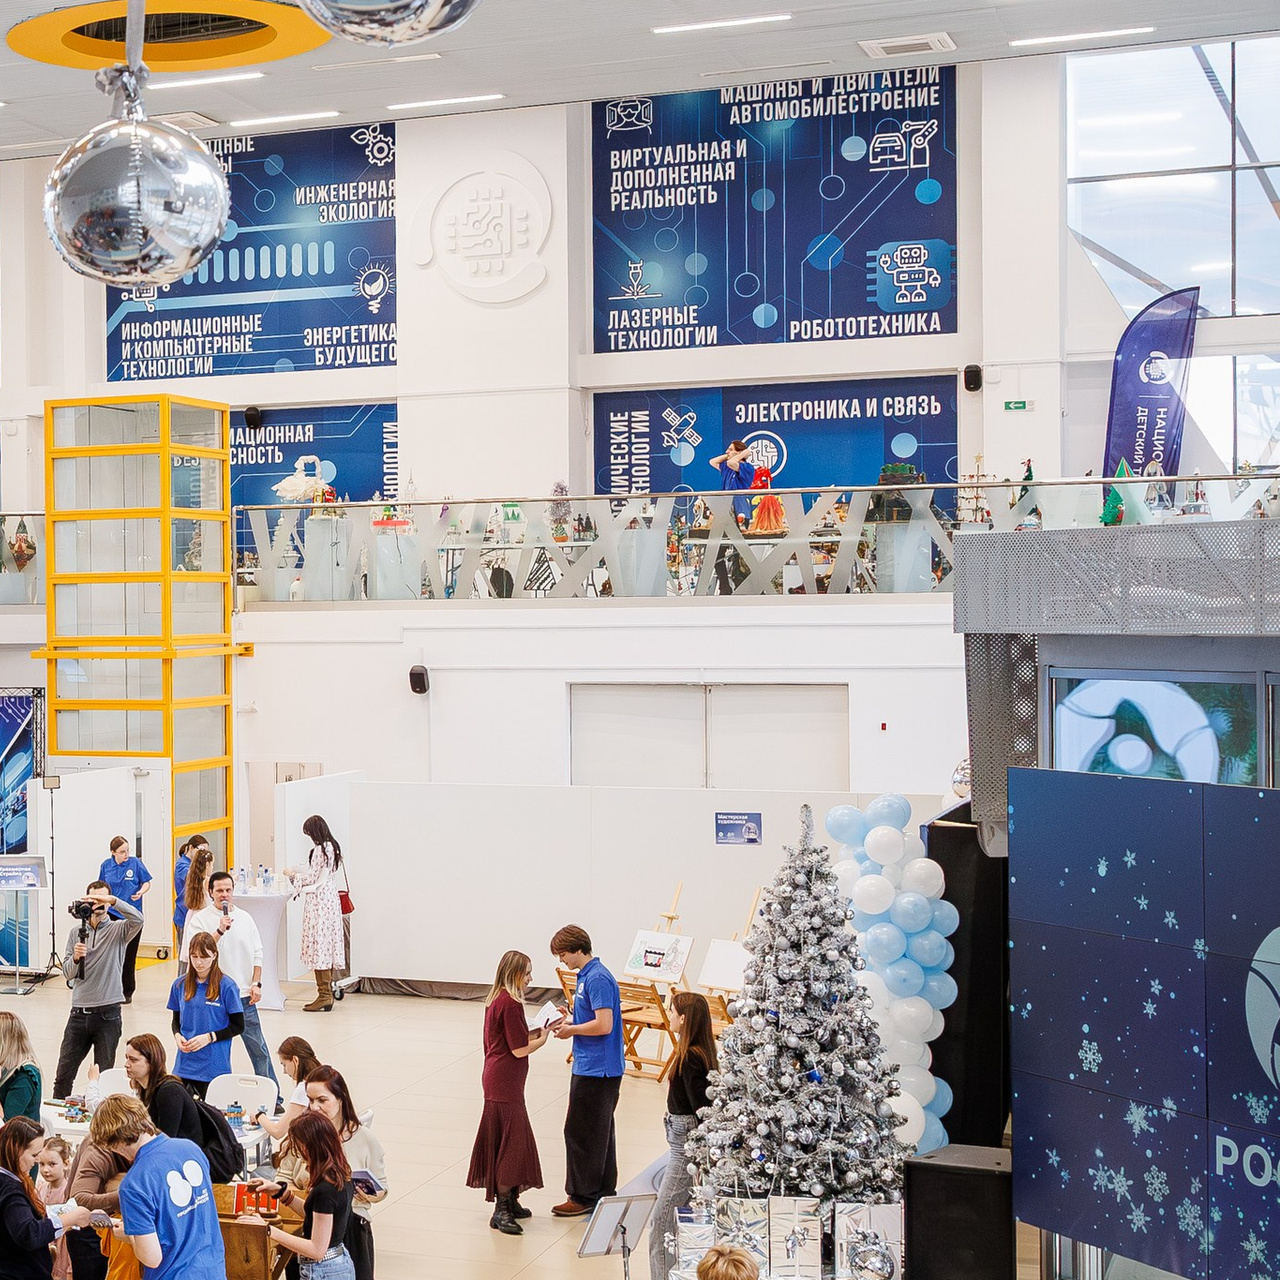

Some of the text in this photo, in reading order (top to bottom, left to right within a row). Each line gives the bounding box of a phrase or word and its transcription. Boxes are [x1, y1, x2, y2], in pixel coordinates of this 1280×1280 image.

[720, 66, 940, 105] МАШИНЫ И ДВИГАТЕЛИ
[729, 86, 940, 125] АВТОМОБИЛЕСТРОЕНИЕ
[610, 138, 747, 169] ВИРТУАЛЬНАЯ И
[610, 161, 736, 192] ДОПОЛНЕННАЯ
[295, 179, 396, 205] ИНЖЕНЕРНАЯ
[610, 185, 718, 211] РЕАЛЬНОСТЬ
[319, 199, 396, 223] ЭКОЛОГИЯ
[121, 314, 263, 341] ИНФОРМАЦИОННЫЕ
[608, 305, 699, 331] ЛАЗЕРНЫЕ
[790, 312, 942, 340] РОБОТОТЕХНИКА
[122, 334, 254, 360] И КОМПЬЮТЕРНЫЕ
[303, 323, 397, 347] ЭНЕРГЕТИКА
[608, 325, 718, 351] ТЕХНОЛОГИИ
[122, 357, 213, 379] ТЕХНОЛОГИИ
[315, 343, 397, 367] БУДУЩЕГО
[735, 395, 942, 424] ЭЛЕКТРОНИКА И СВЯЗЬ
[1133, 406, 1148, 464] ДЕТСКИЙ
[1151, 407, 1168, 466] НАЦИО
[1216, 1135, 1280, 1188] РО
